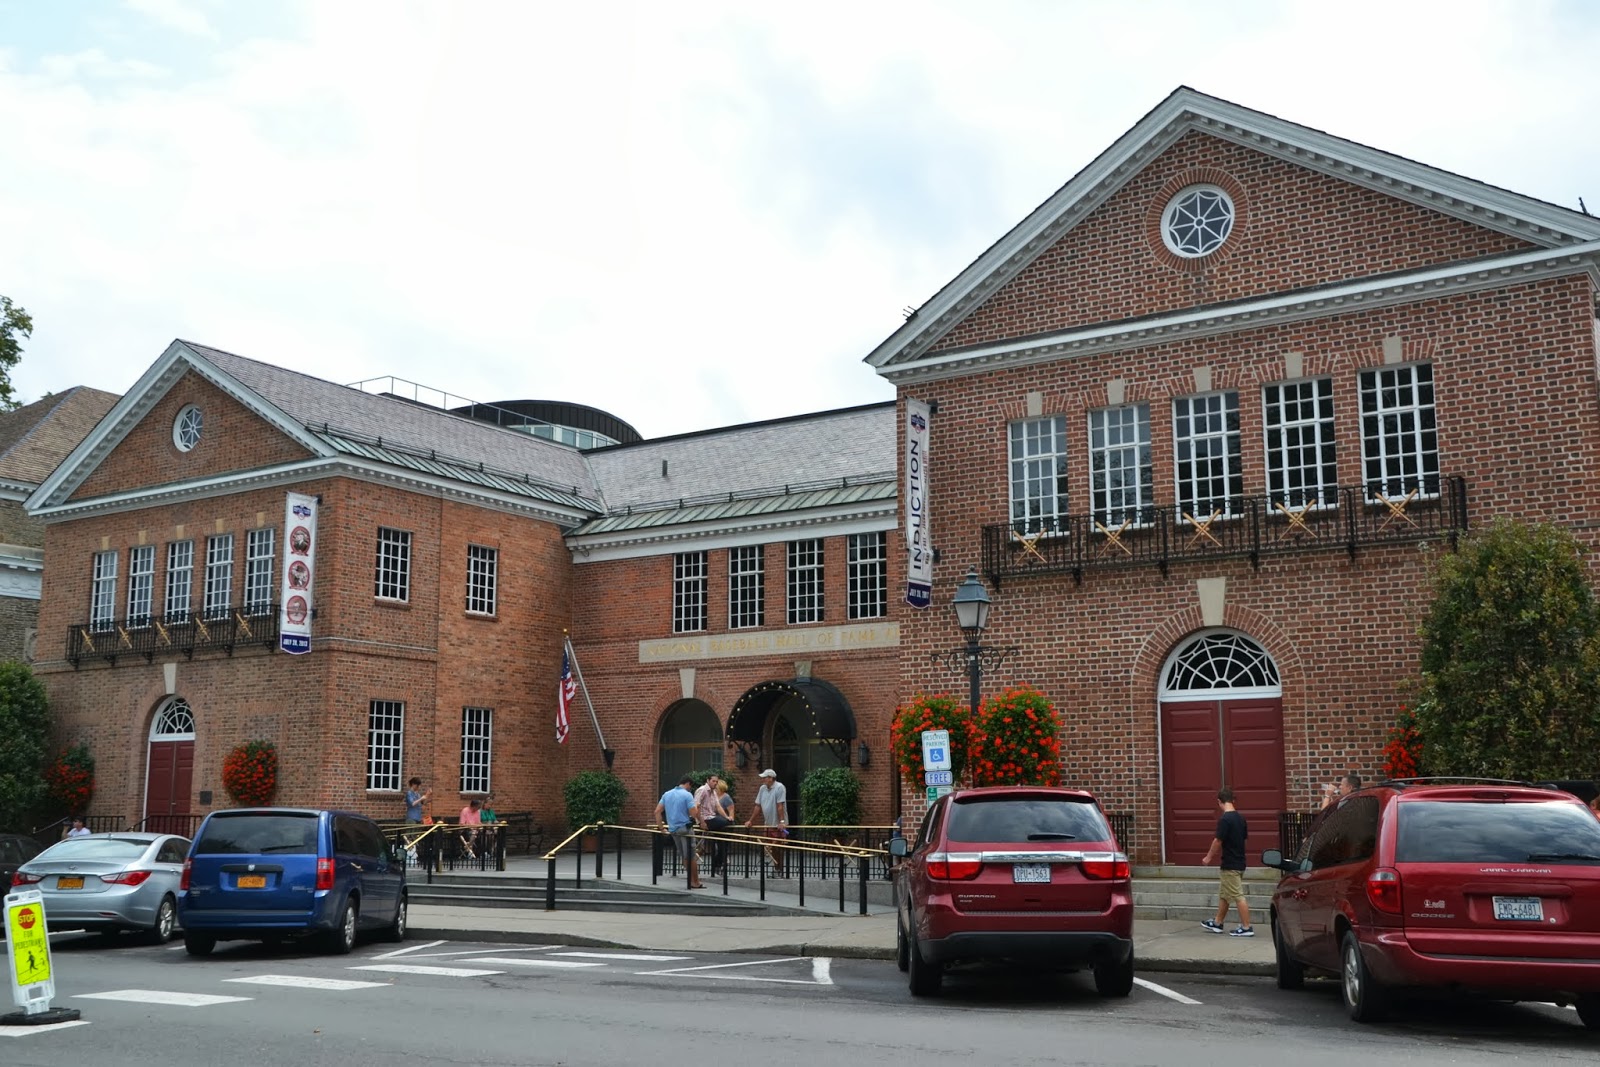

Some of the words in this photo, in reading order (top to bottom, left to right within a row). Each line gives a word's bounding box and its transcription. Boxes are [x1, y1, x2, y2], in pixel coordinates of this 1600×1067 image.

[911, 440, 921, 571] INDUCTION
[648, 642, 702, 656] NATIONAL
[709, 637, 769, 652] BASEBALL
[775, 632, 808, 646] HALL
[817, 631, 833, 645] OF
[841, 629, 875, 643] FAME
[923, 733, 948, 741] RESERVED
[929, 773, 948, 783] FREE
[18, 913, 36, 924] STOP
[23, 930, 34, 938] FOR
